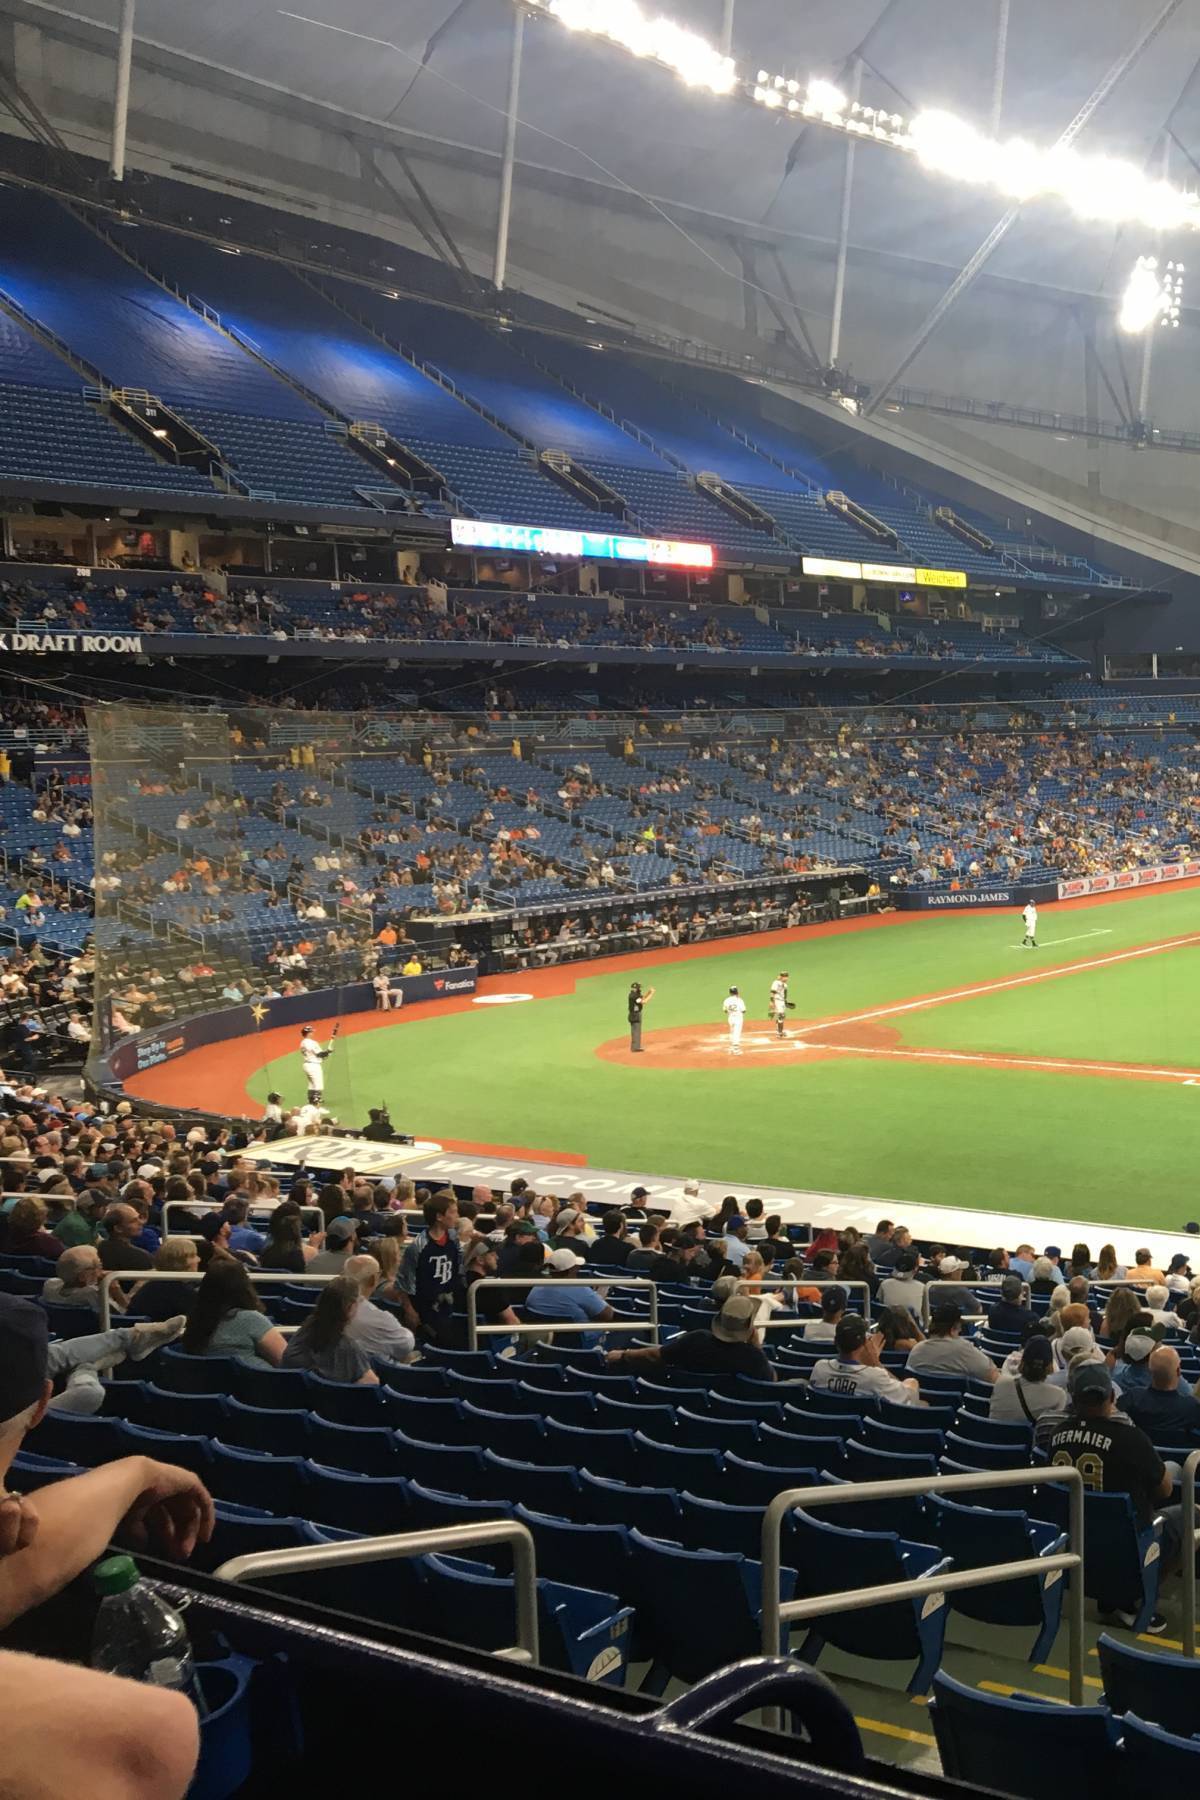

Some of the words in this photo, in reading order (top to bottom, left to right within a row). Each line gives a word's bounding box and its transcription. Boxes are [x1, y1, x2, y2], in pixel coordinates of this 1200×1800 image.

[12, 633, 77, 651] DRAFT
[82, 635, 143, 653] ROOM
[928, 894, 977, 905] RAYMOND
[978, 892, 1009, 903] JAMES
[445, 979, 475, 990] Fanatics
[423, 1160, 706, 1202] WELCOME
[1051, 1429, 1112, 1452] KIERMAIER
